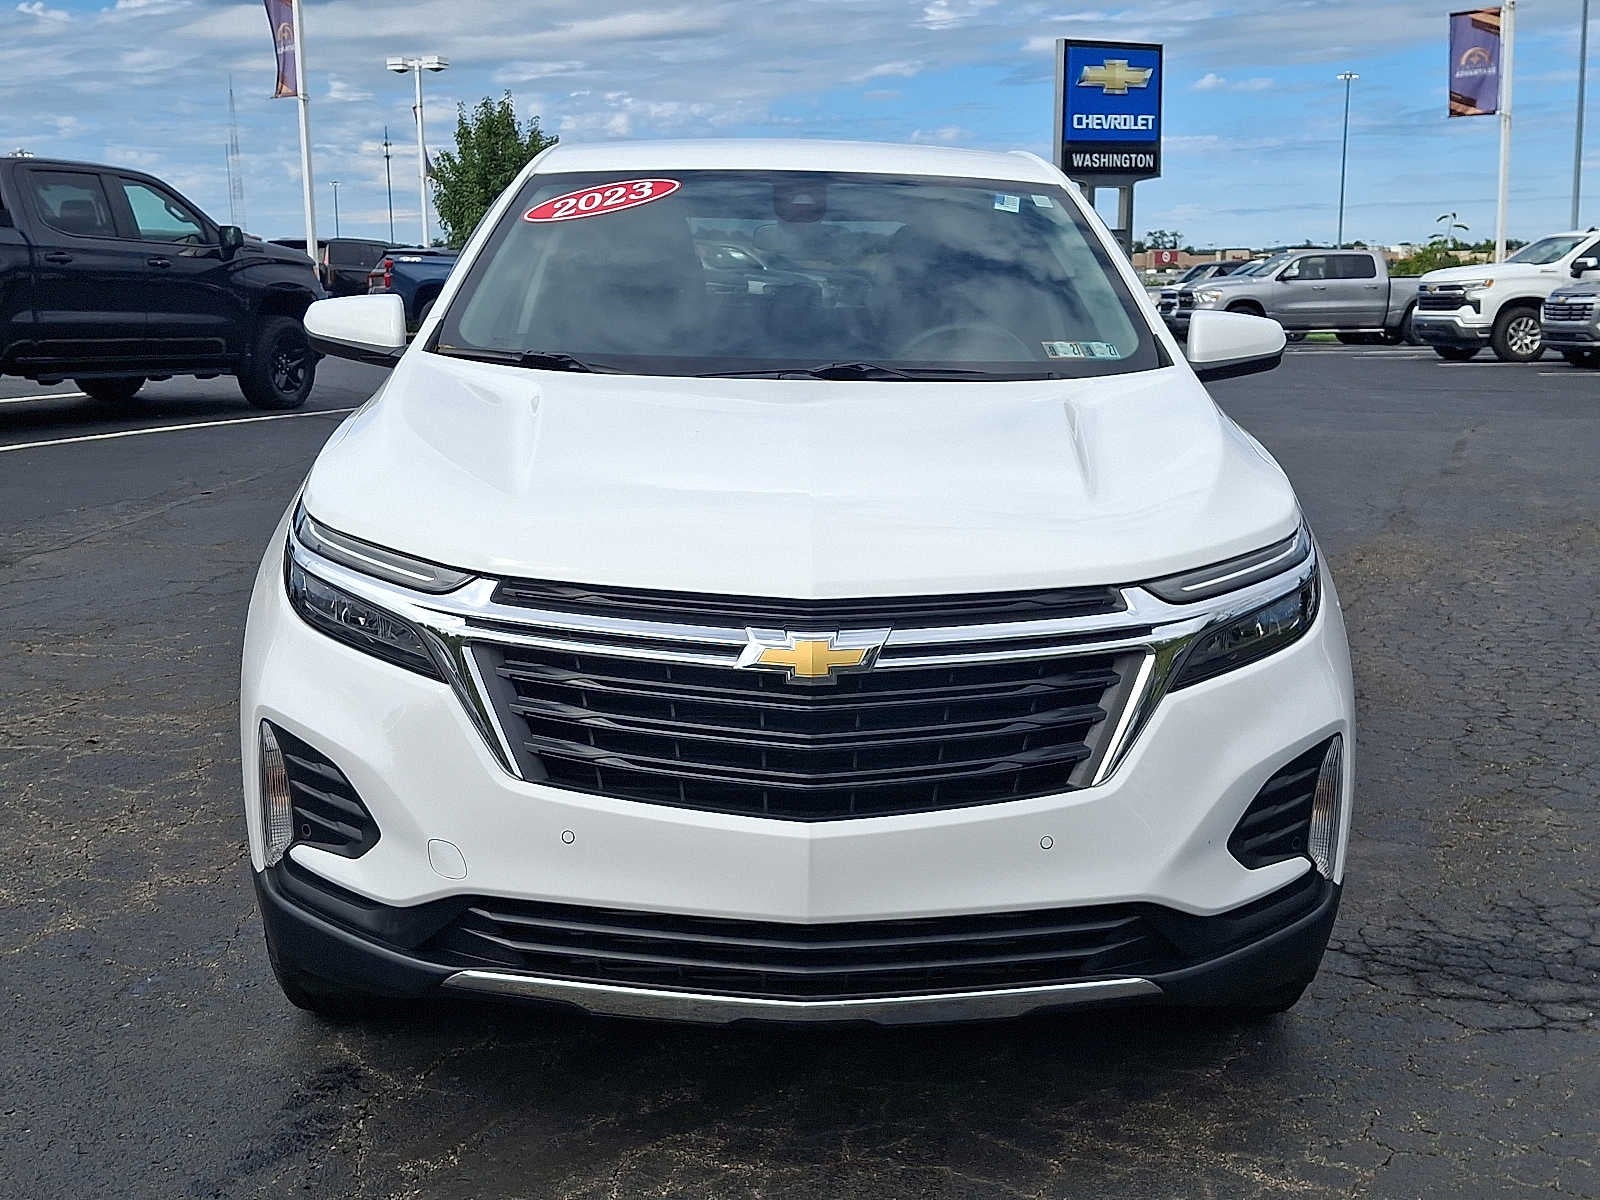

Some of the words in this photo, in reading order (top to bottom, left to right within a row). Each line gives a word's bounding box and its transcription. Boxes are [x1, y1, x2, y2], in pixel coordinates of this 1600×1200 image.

[1072, 114, 1156, 130] CHEVROLET
[1071, 153, 1155, 168] WASHINGTON
[552, 181, 654, 219] 2023
